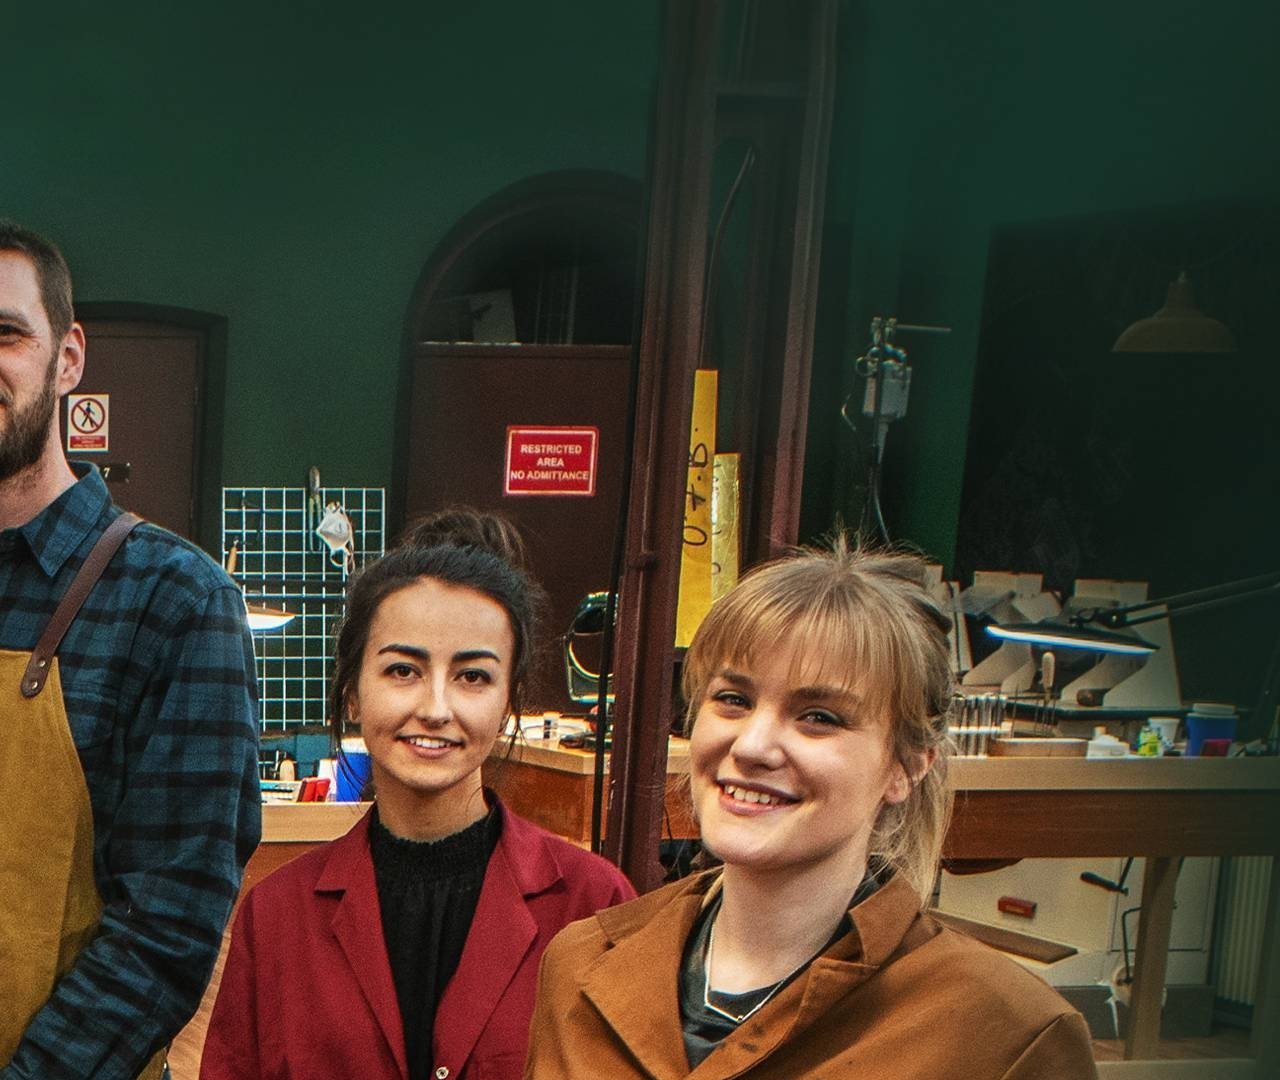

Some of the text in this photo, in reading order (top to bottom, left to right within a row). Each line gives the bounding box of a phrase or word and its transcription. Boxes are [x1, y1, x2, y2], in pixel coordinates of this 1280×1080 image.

[520, 444, 582, 454] RESTRICTED
[536, 457, 564, 467] AREA
[510, 470, 589, 481] NO ADMITTANCE
